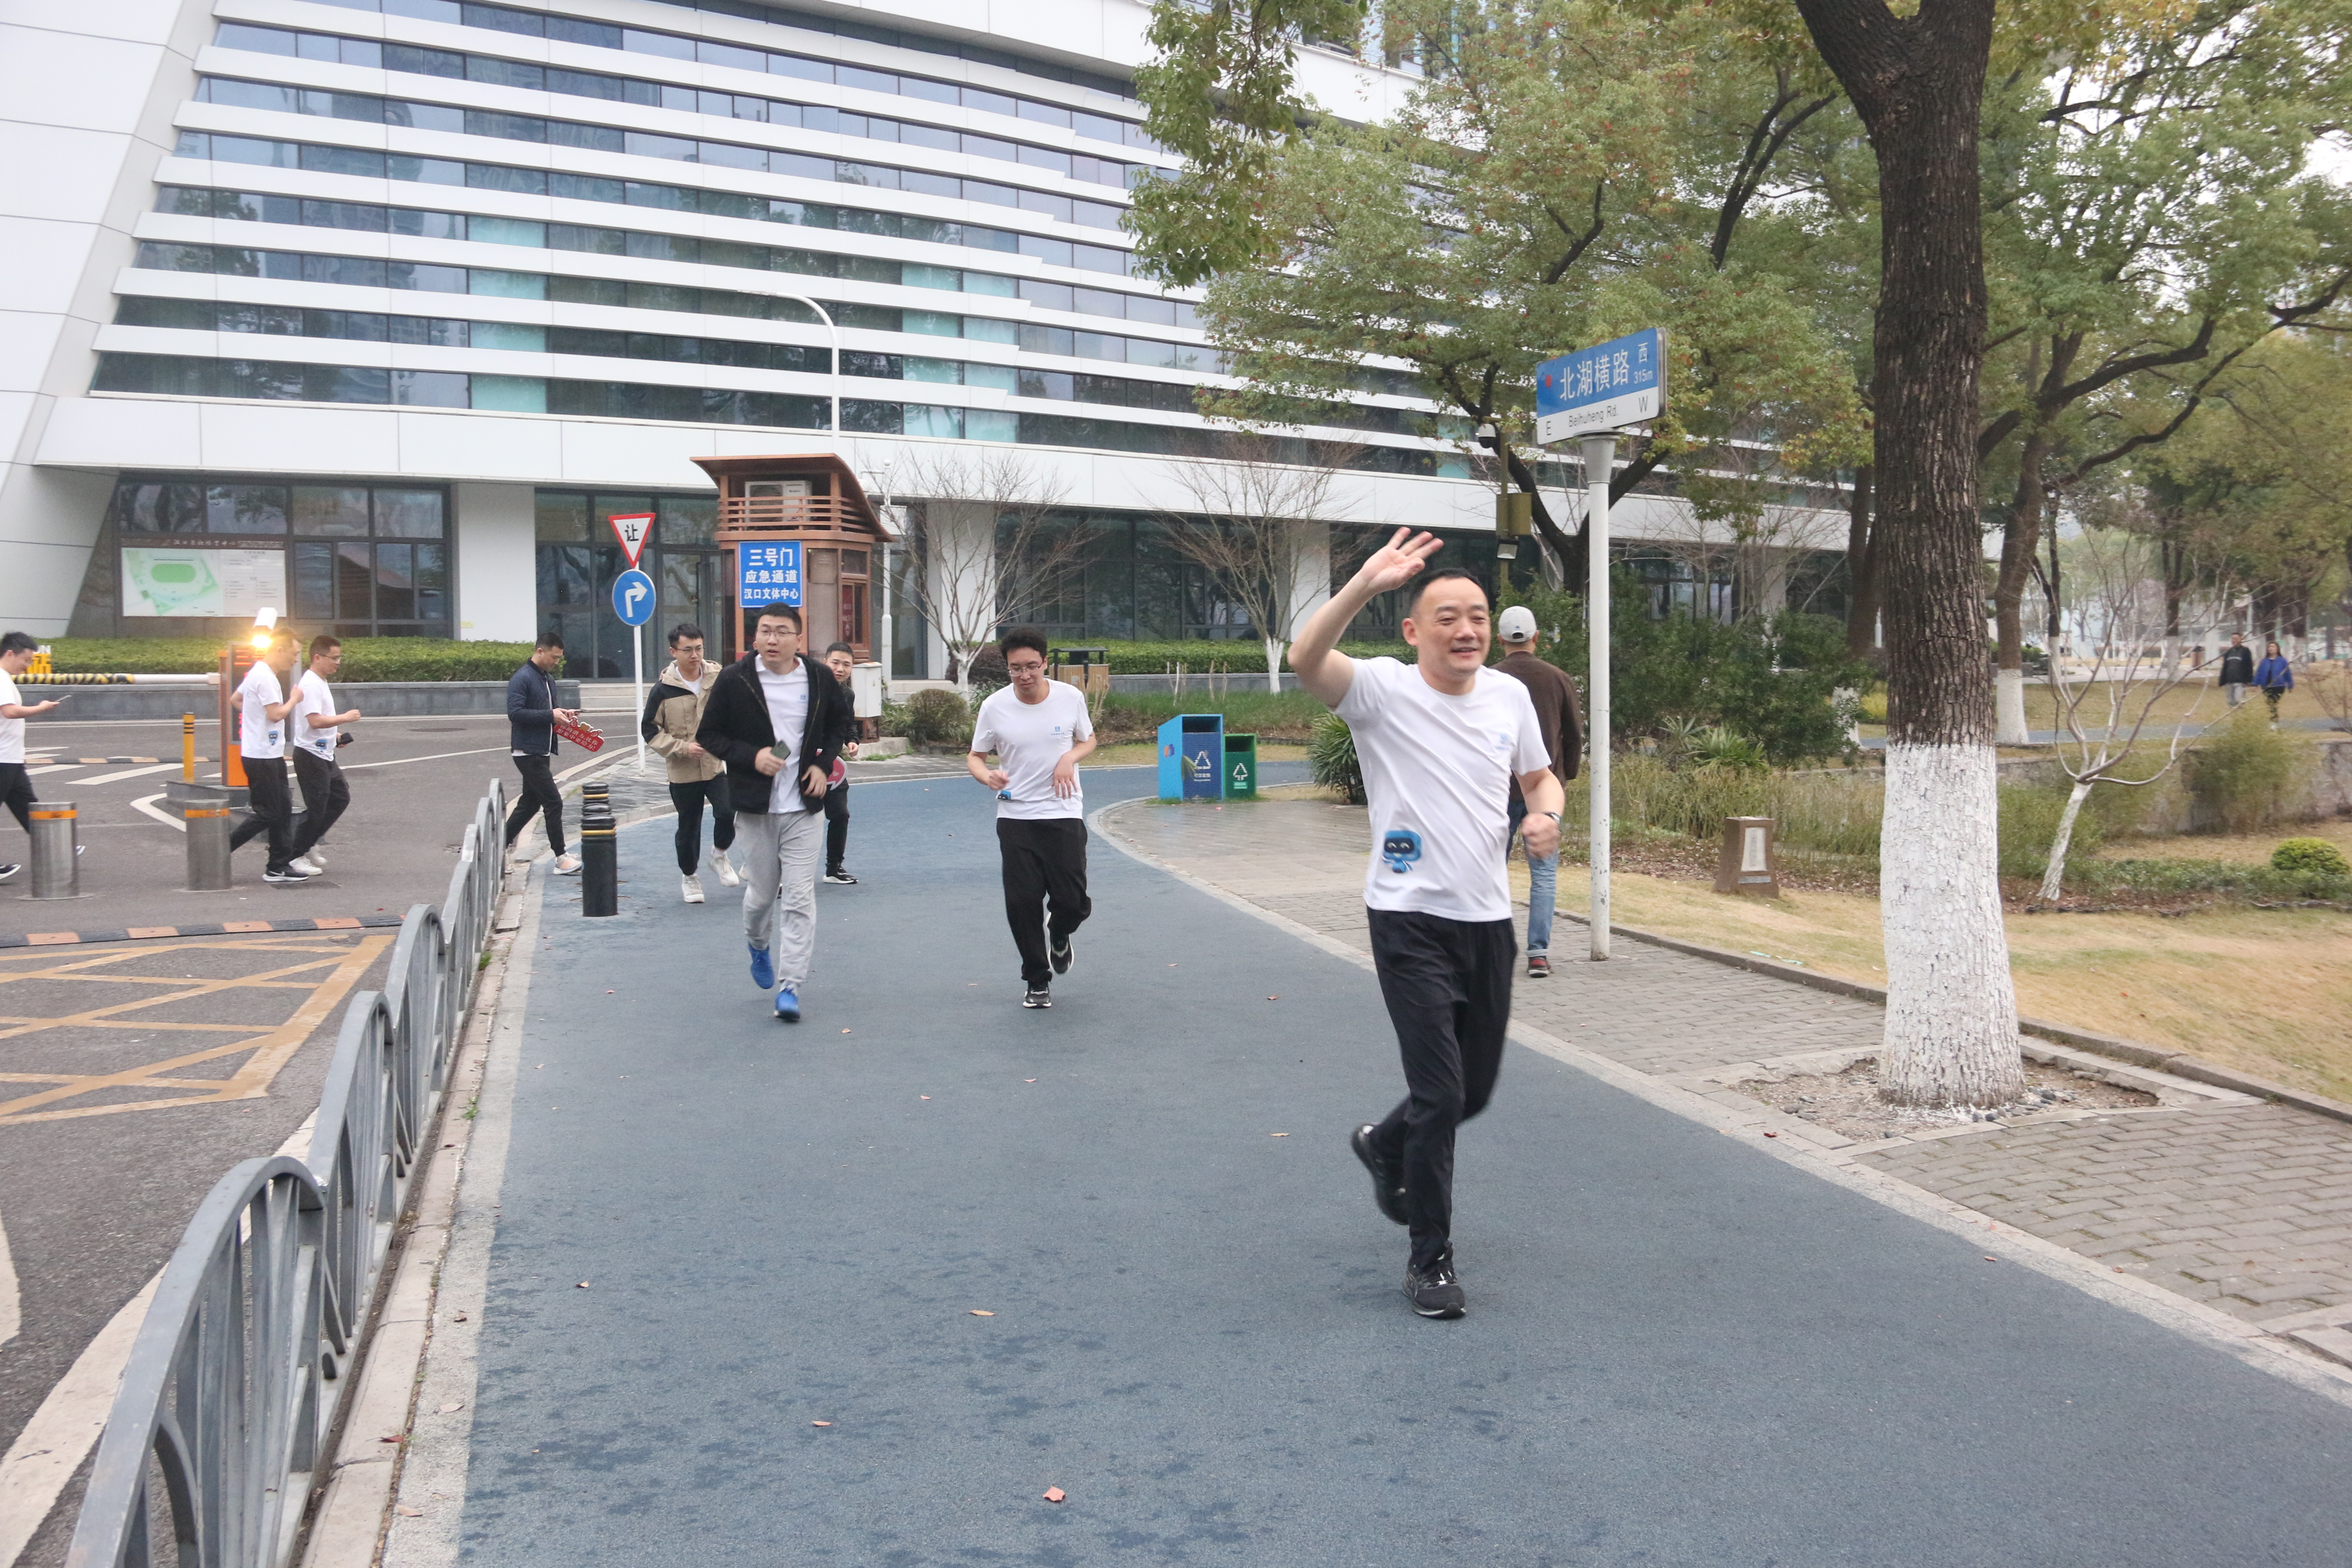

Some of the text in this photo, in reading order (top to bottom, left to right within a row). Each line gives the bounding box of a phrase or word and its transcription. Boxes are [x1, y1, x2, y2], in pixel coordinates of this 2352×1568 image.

[1638, 342, 1648, 364] 西
[1560, 349, 1630, 401] 北湖横路
[1633, 368, 1653, 384] 315m
[1546, 395, 1648, 436] E Beihuheng Rd. W
[625, 524, 639, 542] 让
[749, 547, 793, 567] 三号门
[745, 570, 798, 583] 应急通道
[744, 587, 799, 600] 汉口文体中心
